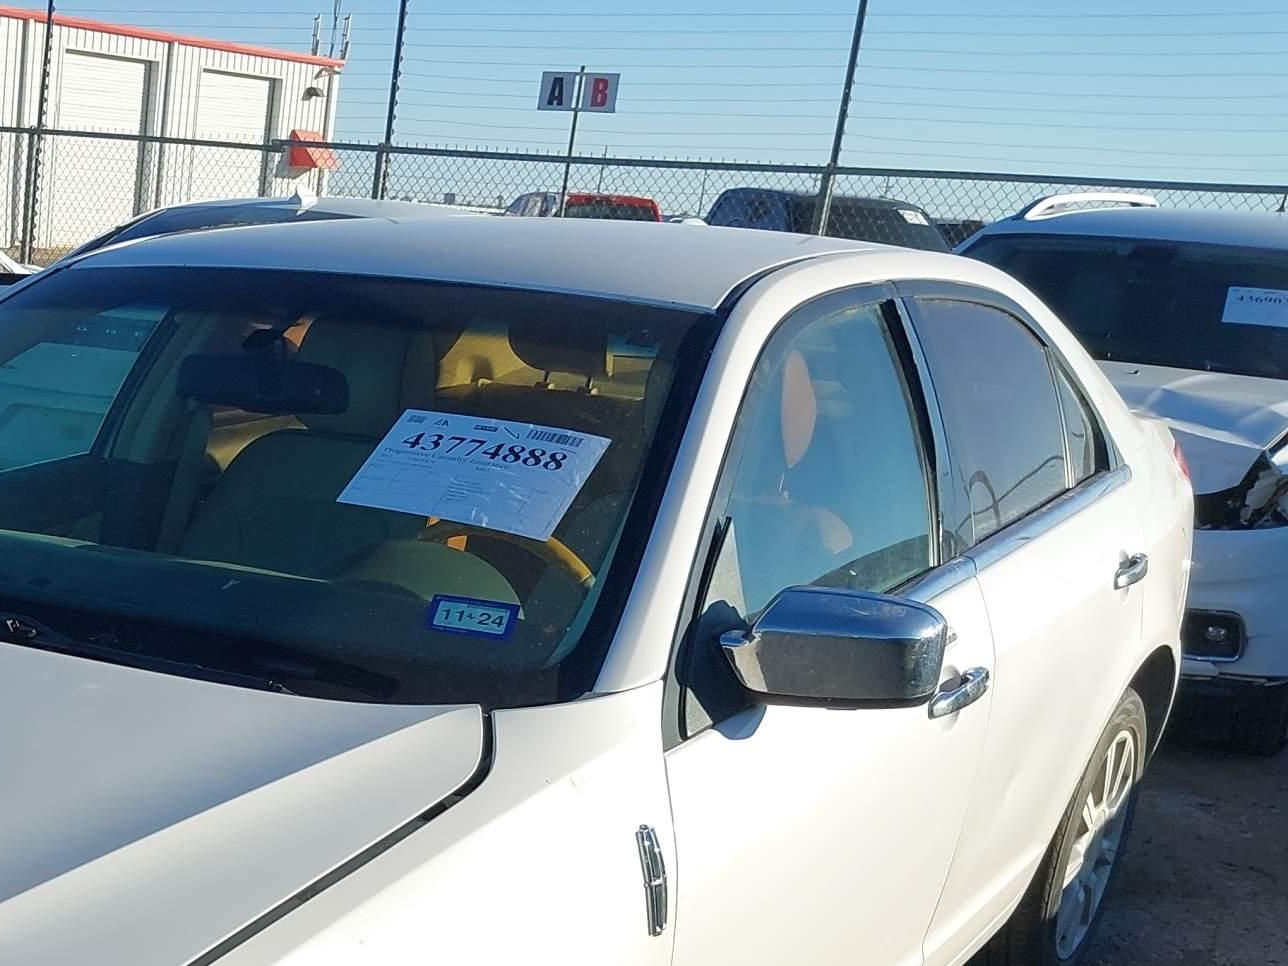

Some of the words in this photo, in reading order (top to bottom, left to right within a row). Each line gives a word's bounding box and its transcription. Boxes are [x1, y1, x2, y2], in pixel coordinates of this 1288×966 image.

[547, 77, 564, 106] A
[590, 78, 609, 107] B
[383, 447, 431, 458] Progressive
[432, 450, 465, 463] Casualty
[402, 432, 568, 470] 43774888
